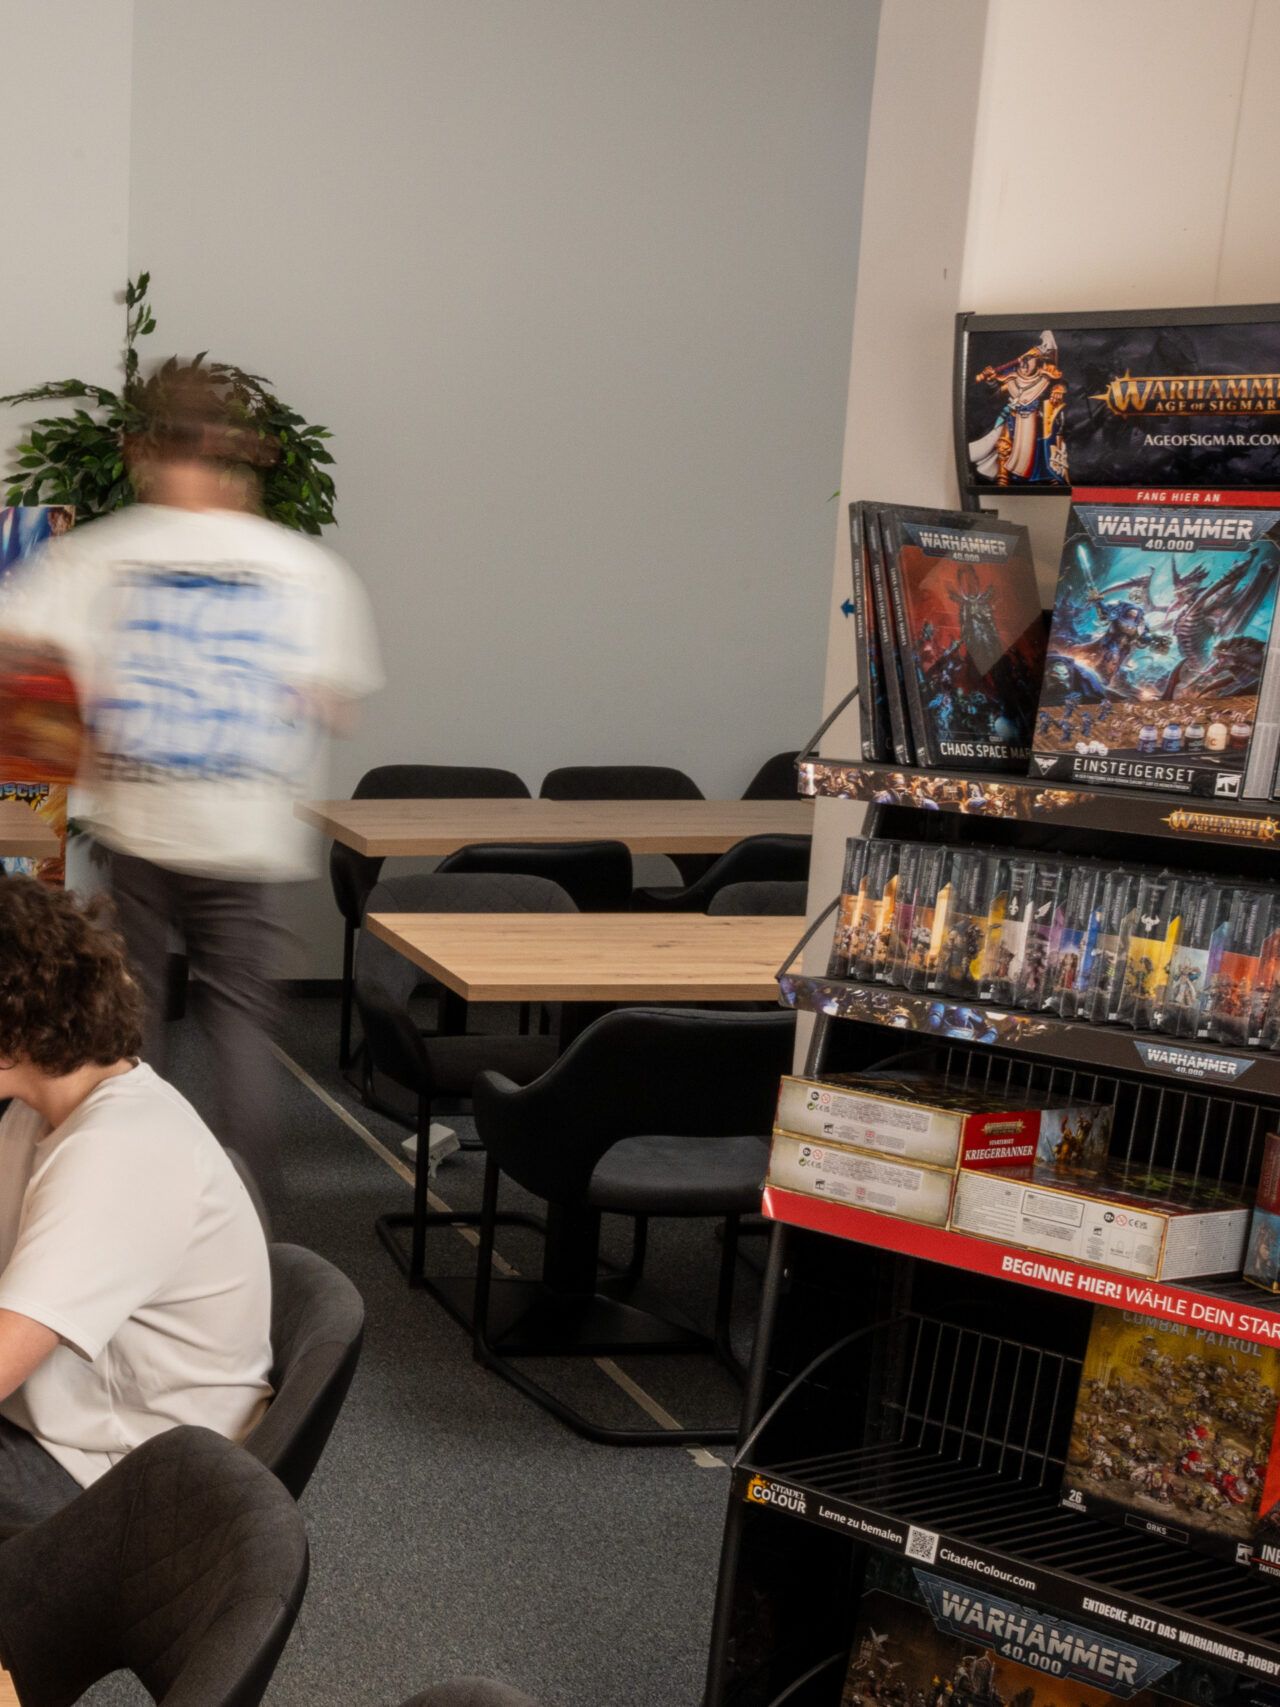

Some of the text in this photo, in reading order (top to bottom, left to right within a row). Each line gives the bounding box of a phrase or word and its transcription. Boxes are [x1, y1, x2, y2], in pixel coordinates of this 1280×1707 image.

[1111, 379, 1280, 412] WARHAMM
[1155, 401, 1187, 412] AGE
[1209, 399, 1277, 412] SIGMAR
[1137, 491, 1221, 503] FANG HIER AN
[1097, 515, 1253, 540] WARHAMMER
[919, 531, 1008, 556] WARHAMMER
[940, 742, 975, 757] CHAOS
[976, 744, 1009, 759] SPACE
[1073, 758, 1195, 783] EINSTEIGERSET
[1147, 1048, 1238, 1075] WARHAMMER
[964, 1145, 1034, 1160] KRIEGERBANNER
[1001, 1255, 1074, 1288] BEGINNE
[1076, 1274, 1122, 1300] HIER!
[1126, 1286, 1187, 1317] WÄHLE
[1191, 1302, 1234, 1328] DEIN
[752, 1485, 807, 1515] COLOUR
[770, 1482, 805, 1501] CITADEL
[1068, 1489, 1083, 1504] 26
[1146, 1522, 1167, 1535] ORKS
[818, 1506, 1036, 1591] Lerne zu bemalen CitadelColour.com
[941, 1590, 1139, 1685] WARHAMMER
[1082, 1597, 1280, 1677] ENTDECKE JETZT DAS WARHAMMER-HOBBY
